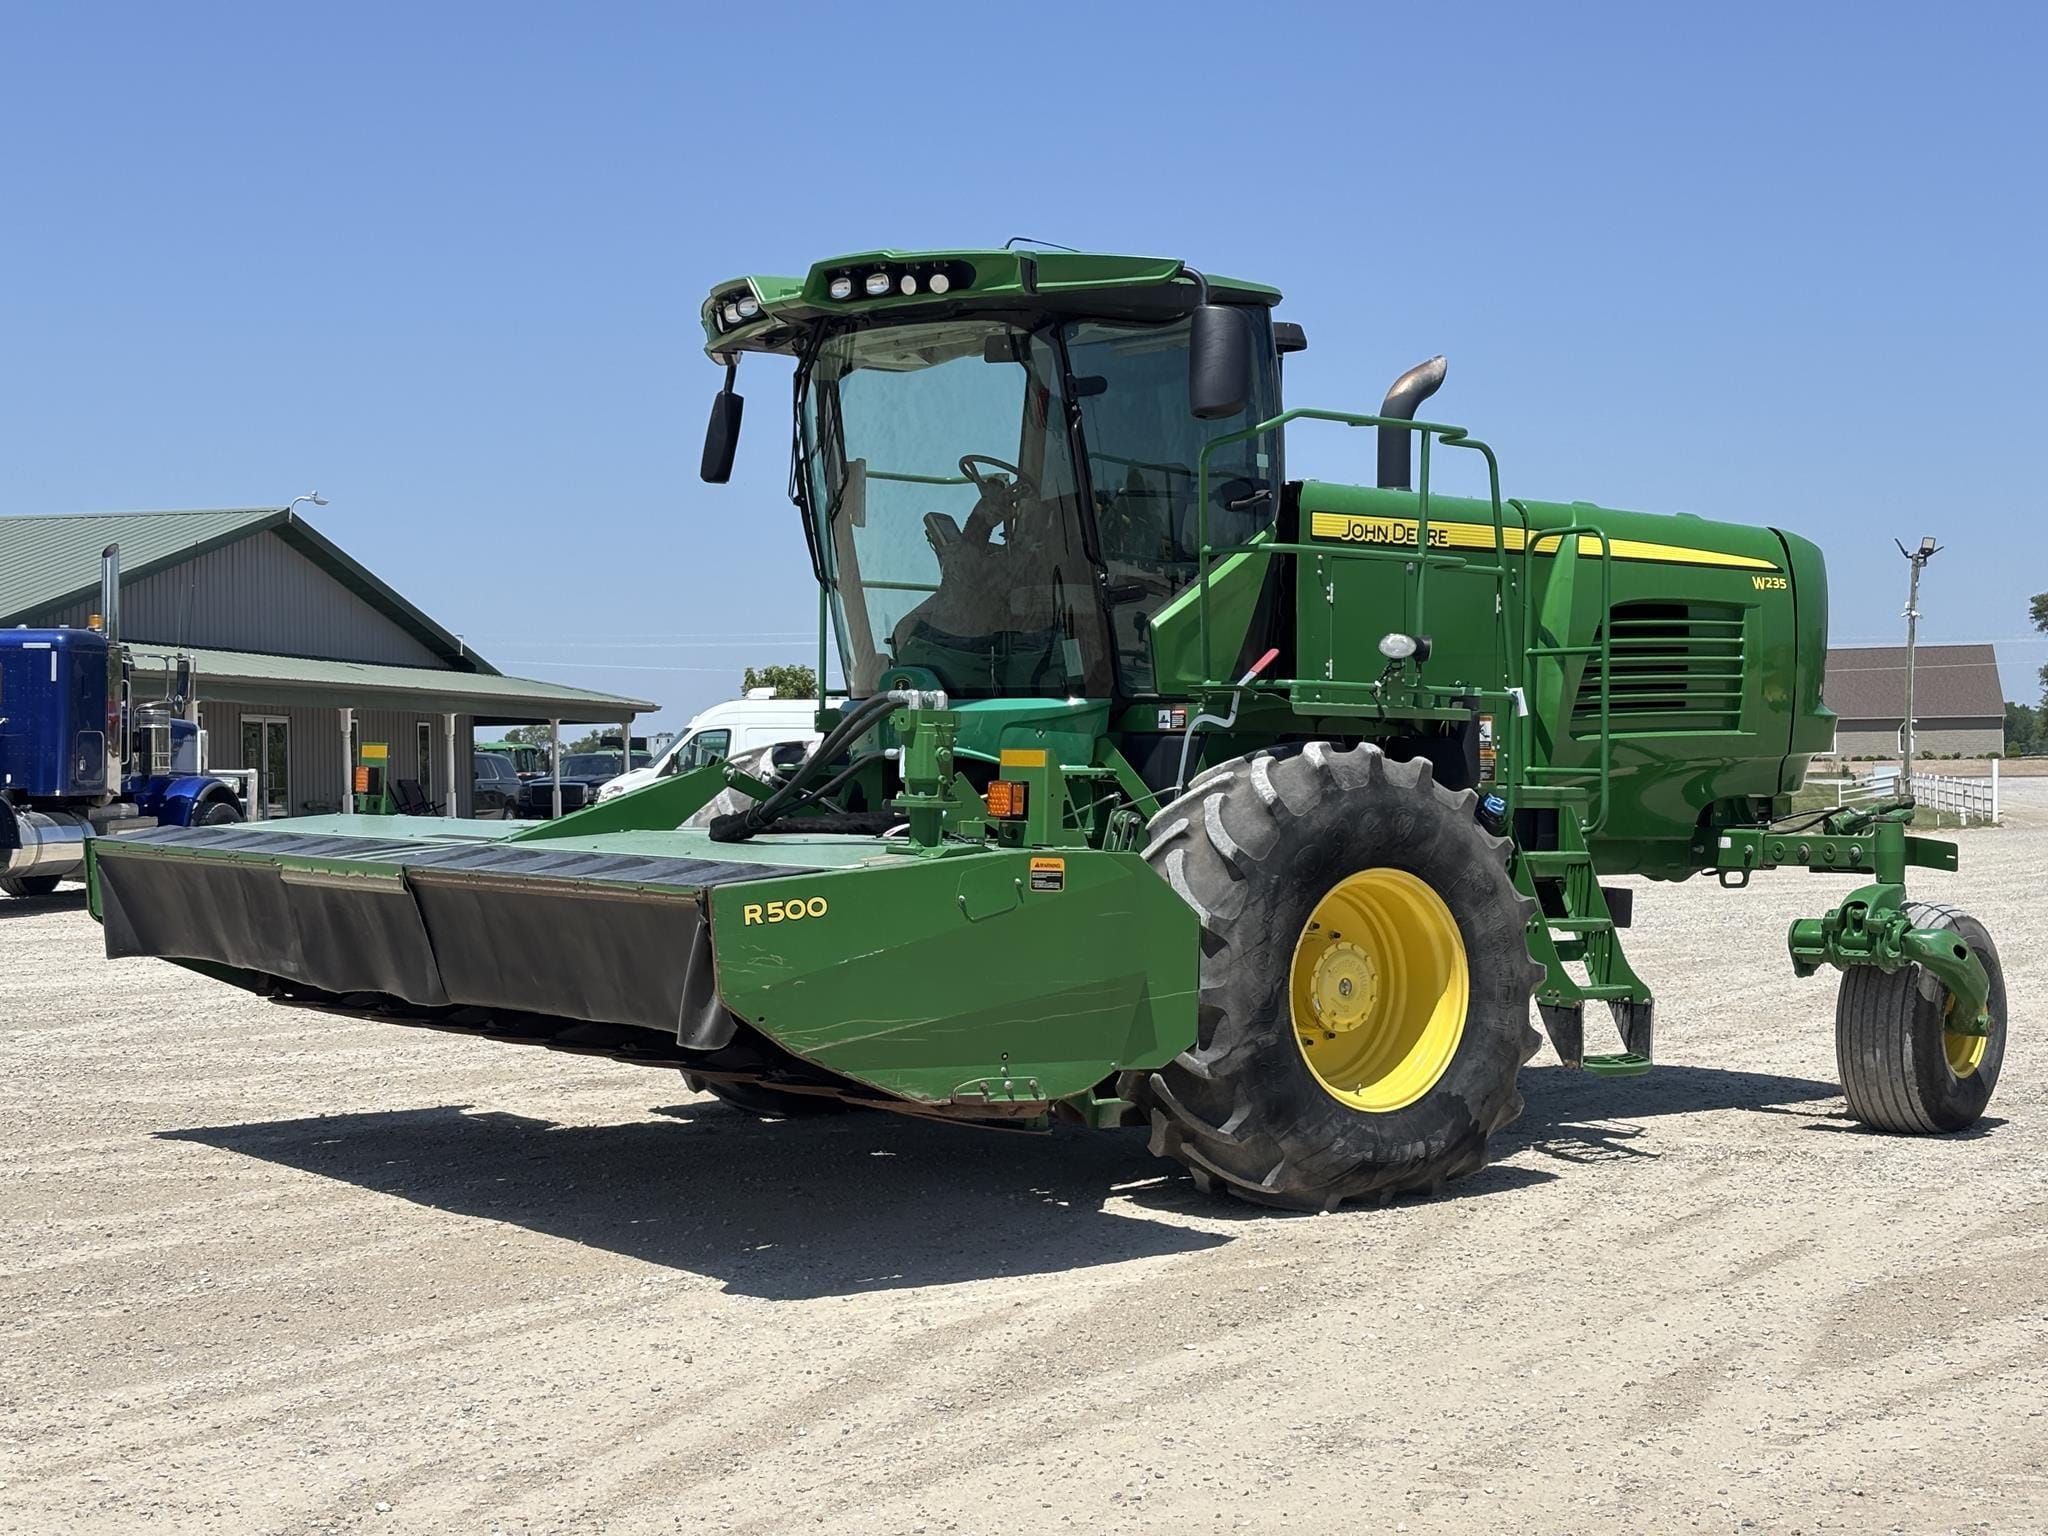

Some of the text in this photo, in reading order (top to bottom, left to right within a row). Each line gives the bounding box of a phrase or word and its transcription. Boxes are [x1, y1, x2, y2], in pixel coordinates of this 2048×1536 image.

[1341, 519, 1449, 545] JOHN DERE
[1751, 575, 1787, 590] W235
